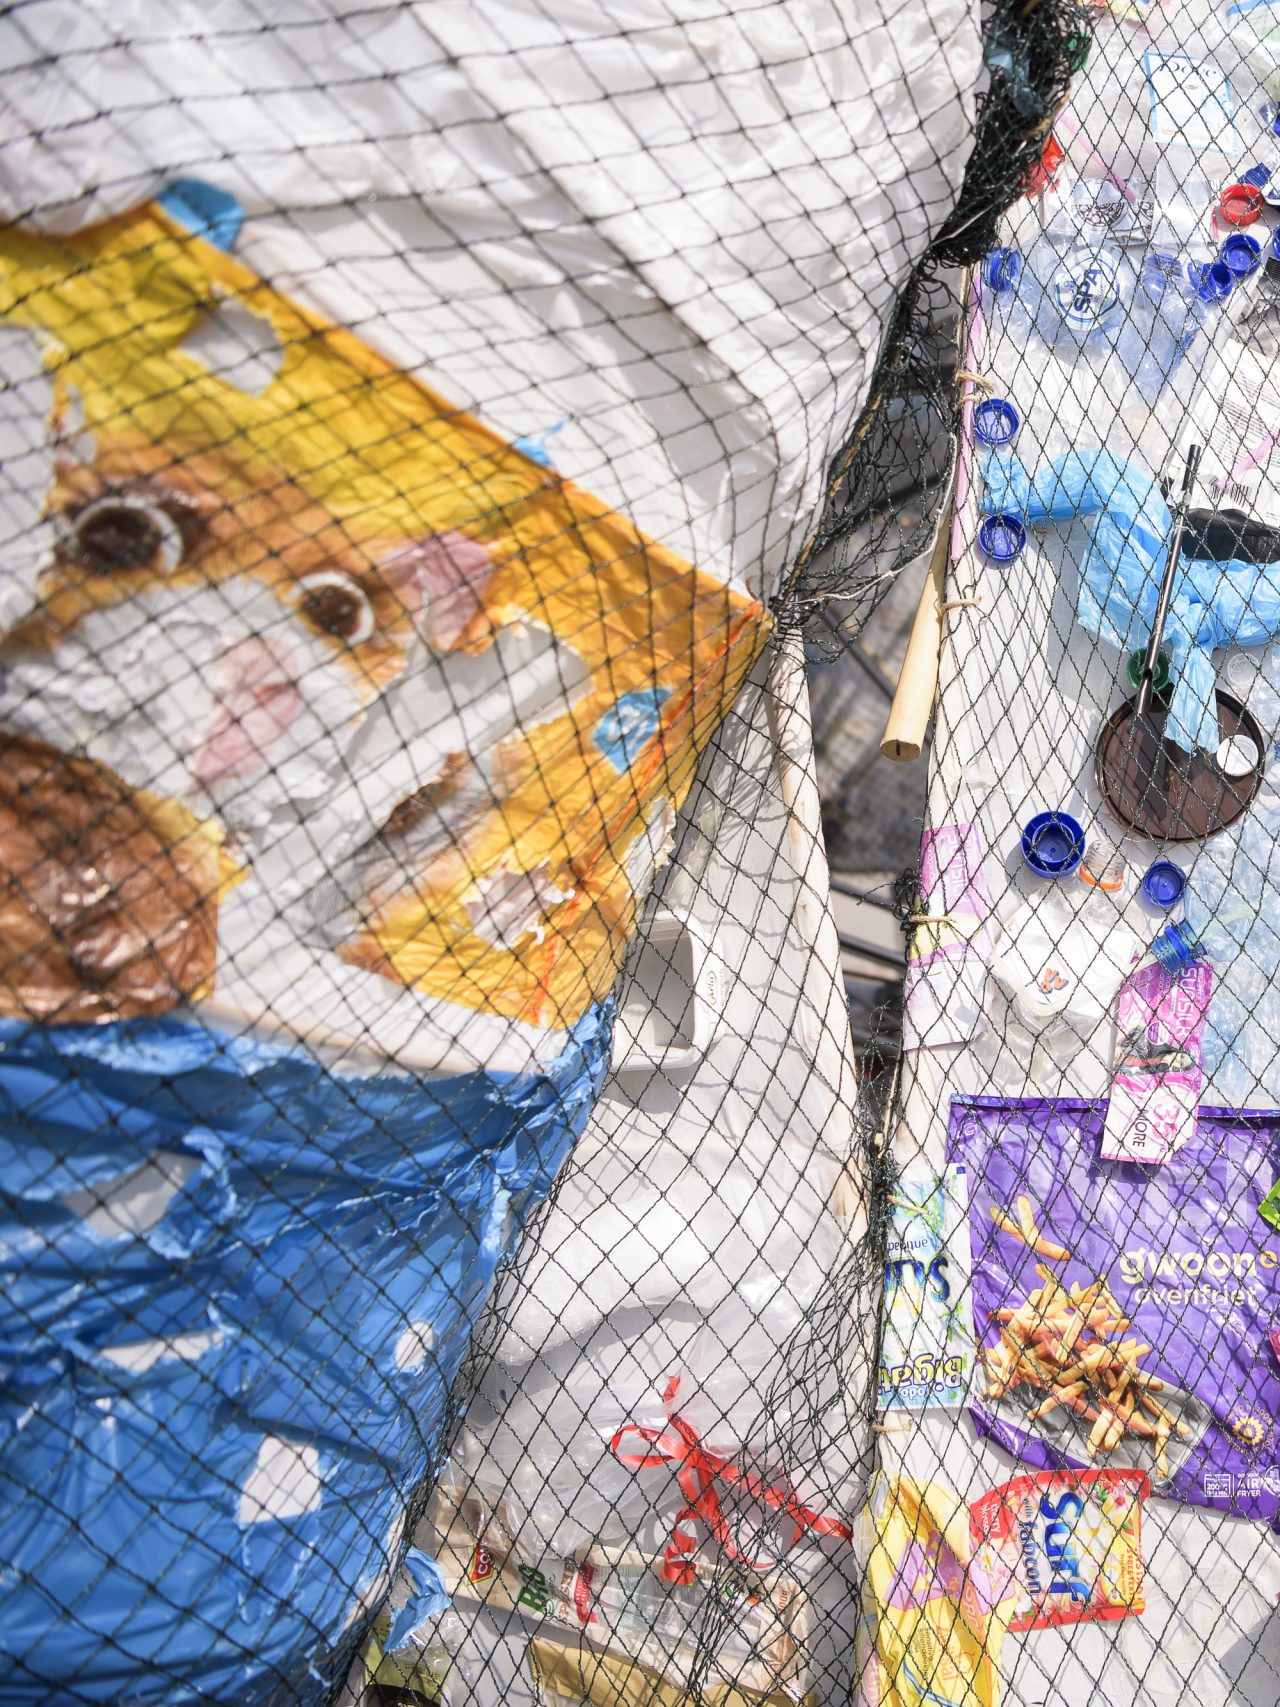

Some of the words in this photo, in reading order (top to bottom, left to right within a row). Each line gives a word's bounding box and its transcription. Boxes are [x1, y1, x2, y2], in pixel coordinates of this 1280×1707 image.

[1073, 268, 1101, 314] SPA
[1119, 1247, 1257, 1285] gwoon
[1134, 1284, 1257, 1306] ovenfriet
[1236, 1489, 1261, 1497] FRYER
[1039, 1491, 1092, 1603] Surf
